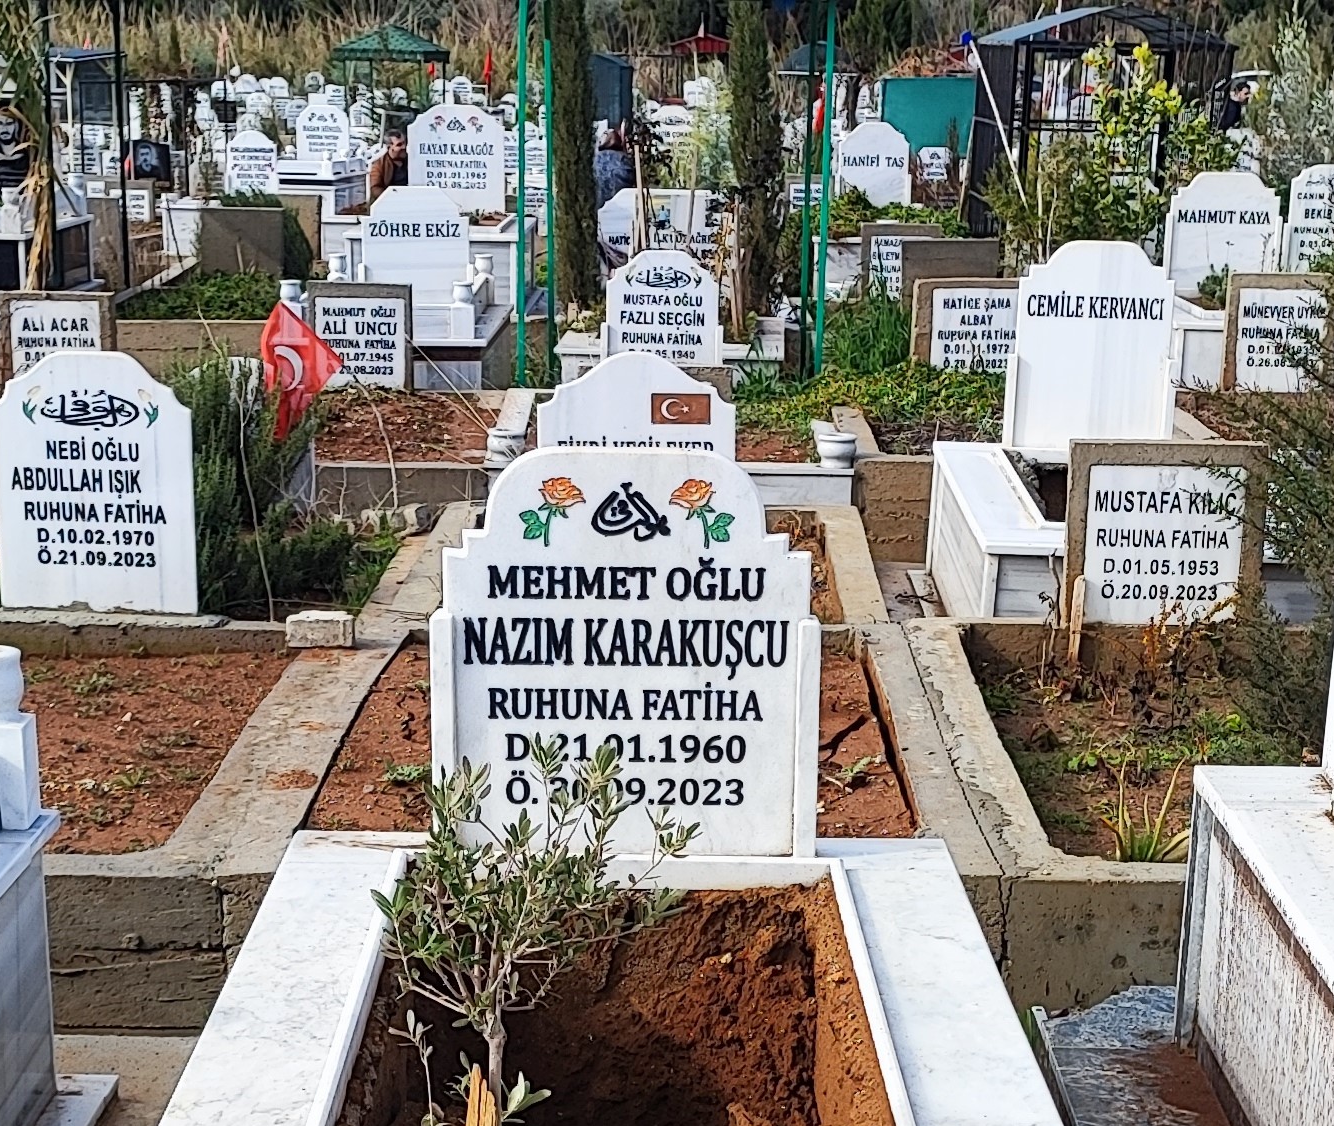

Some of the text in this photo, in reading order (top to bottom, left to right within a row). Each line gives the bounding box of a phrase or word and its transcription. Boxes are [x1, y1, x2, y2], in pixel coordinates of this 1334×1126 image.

[449, 141, 495, 156] KARAGÖZ
[842, 154, 905, 170] HANİFİ TAŞ
[1177, 209, 1271, 225] MAHMUT KAYA
[368, 219, 461, 238] ZÖHRE EKİZ
[623, 292, 703, 307] MUSTAFA OĞLU
[1026, 290, 1165, 321] CEMİLE KERVANCI
[322, 305, 397, 318] MAHMUT OĞLU
[620, 310, 655, 325] FAZLI
[959, 314, 994, 327] ALBAY
[50, 317, 89, 332] ACAR
[322, 318, 398, 336] ALİ UNCU
[981, 327, 1017, 341] FATİHA
[61, 333, 96, 348] FATİHA
[364, 338, 397, 350] FATİHA
[621, 330, 703, 346] RUHUNA FATİHA
[45, 436, 140, 463] NEBİ OĞLU
[11, 466, 142, 499] ABDULLAH IŞIK
[23, 498, 167, 525] RUHUNA FATİHA
[1093, 489, 1183, 515] MUSTAFA
[37, 527, 155, 547] D.10.02.1970
[1095, 523, 1230, 551] RUHUNA FATİHA
[37, 545, 157, 568] Ö.21.09.2023
[1102, 558, 1220, 577] D.01.05.1953
[487, 556, 767, 601] MEHMET OĞLU
[1100, 579, 1219, 602] Ö.20.09.2023
[463, 616, 790, 682] NAZIM KARAKUŞCU
[487, 681, 764, 723] RUHUNA FATİHA
